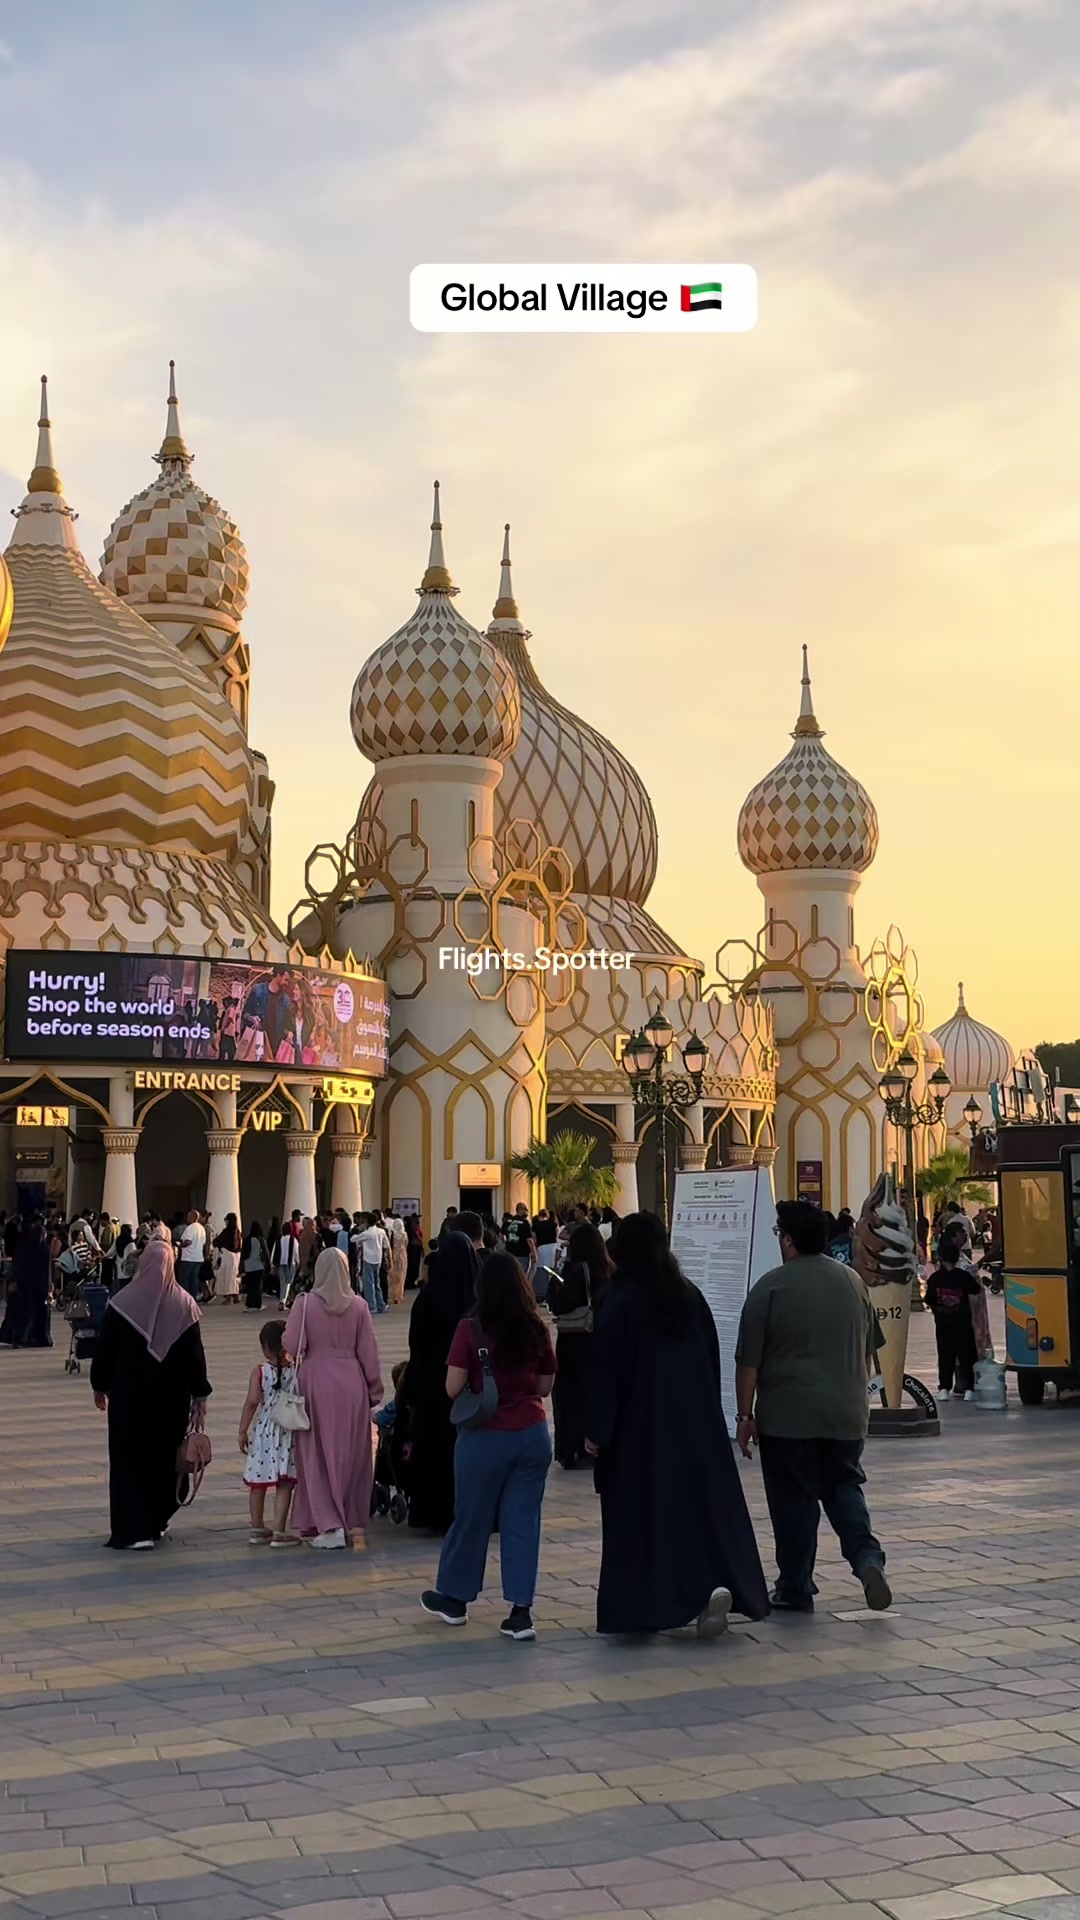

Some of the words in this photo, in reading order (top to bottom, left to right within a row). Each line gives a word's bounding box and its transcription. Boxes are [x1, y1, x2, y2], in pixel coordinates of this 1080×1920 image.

[29, 970, 105, 995] Hurry!
[27, 996, 80, 1016] Shop
[85, 997, 116, 1013] the
[121, 999, 174, 1015] world
[27, 1018, 92, 1036] before
[97, 1023, 164, 1037] season
[168, 1023, 211, 1039] ends
[135, 1071, 241, 1091] ENTRANCE
[252, 1111, 282, 1131] VIP
[904, 1378, 935, 1412] Chocolate
